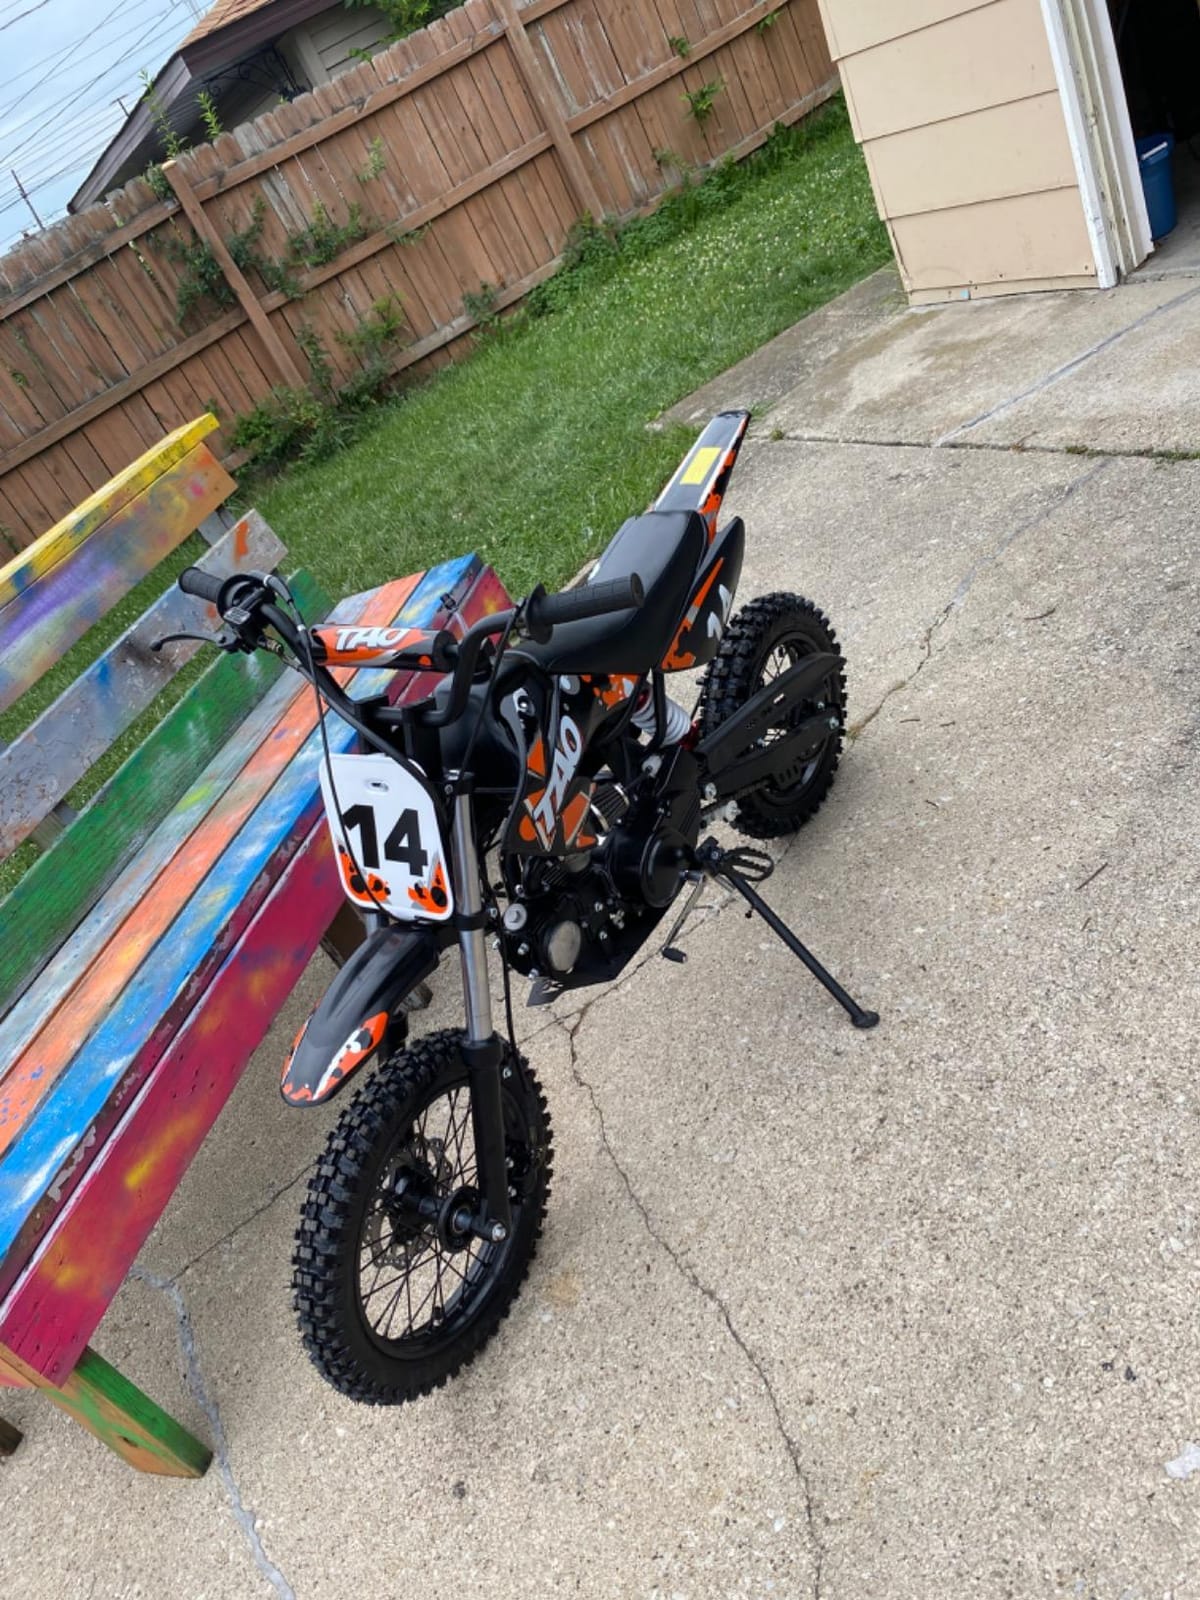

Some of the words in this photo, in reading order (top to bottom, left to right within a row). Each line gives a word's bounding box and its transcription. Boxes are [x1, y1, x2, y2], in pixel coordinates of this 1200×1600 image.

[335, 627, 411, 651] TAO
[533, 715, 583, 834] TAO
[341, 804, 428, 877] 14
